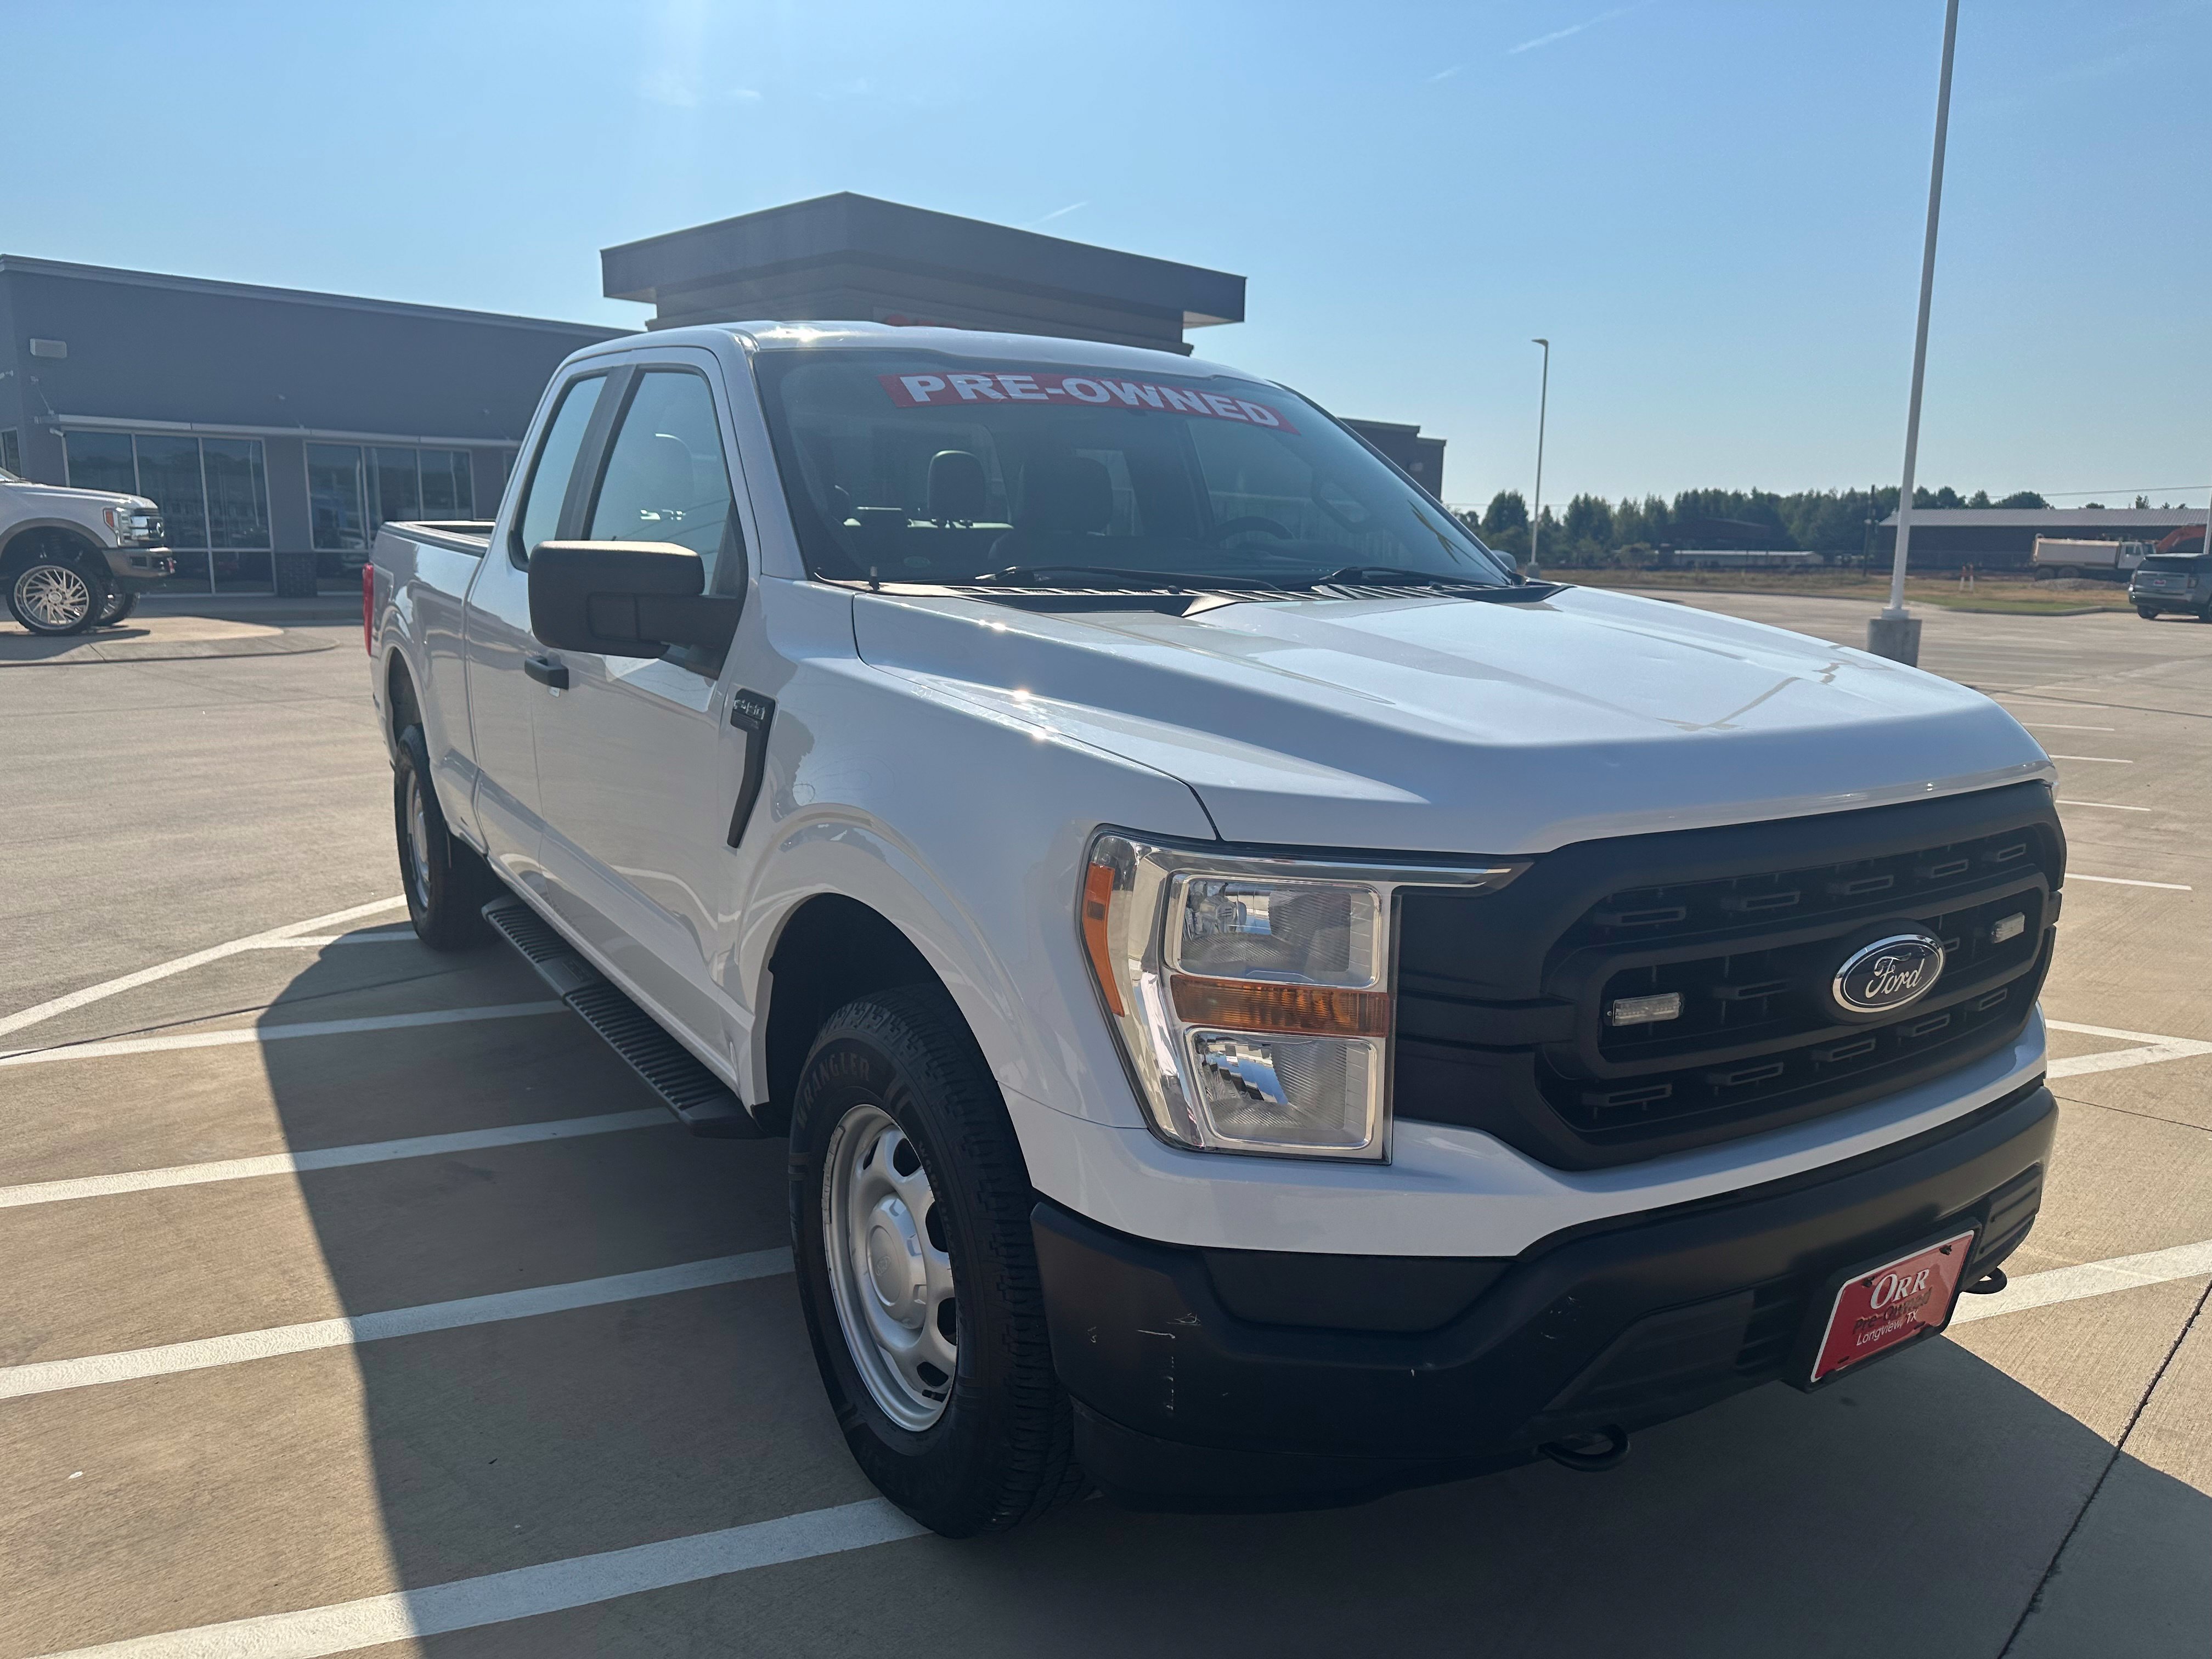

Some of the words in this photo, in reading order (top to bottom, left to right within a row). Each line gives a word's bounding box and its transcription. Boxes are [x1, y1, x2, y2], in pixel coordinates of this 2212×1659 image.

[899, 374, 1280, 427] PRE-OWNED
[1865, 952, 1925, 998] Ford
[1870, 1268, 1929, 1310] ORR
[1856, 1320, 1903, 1346] Longview,
[1905, 1309, 1919, 1324] TX
